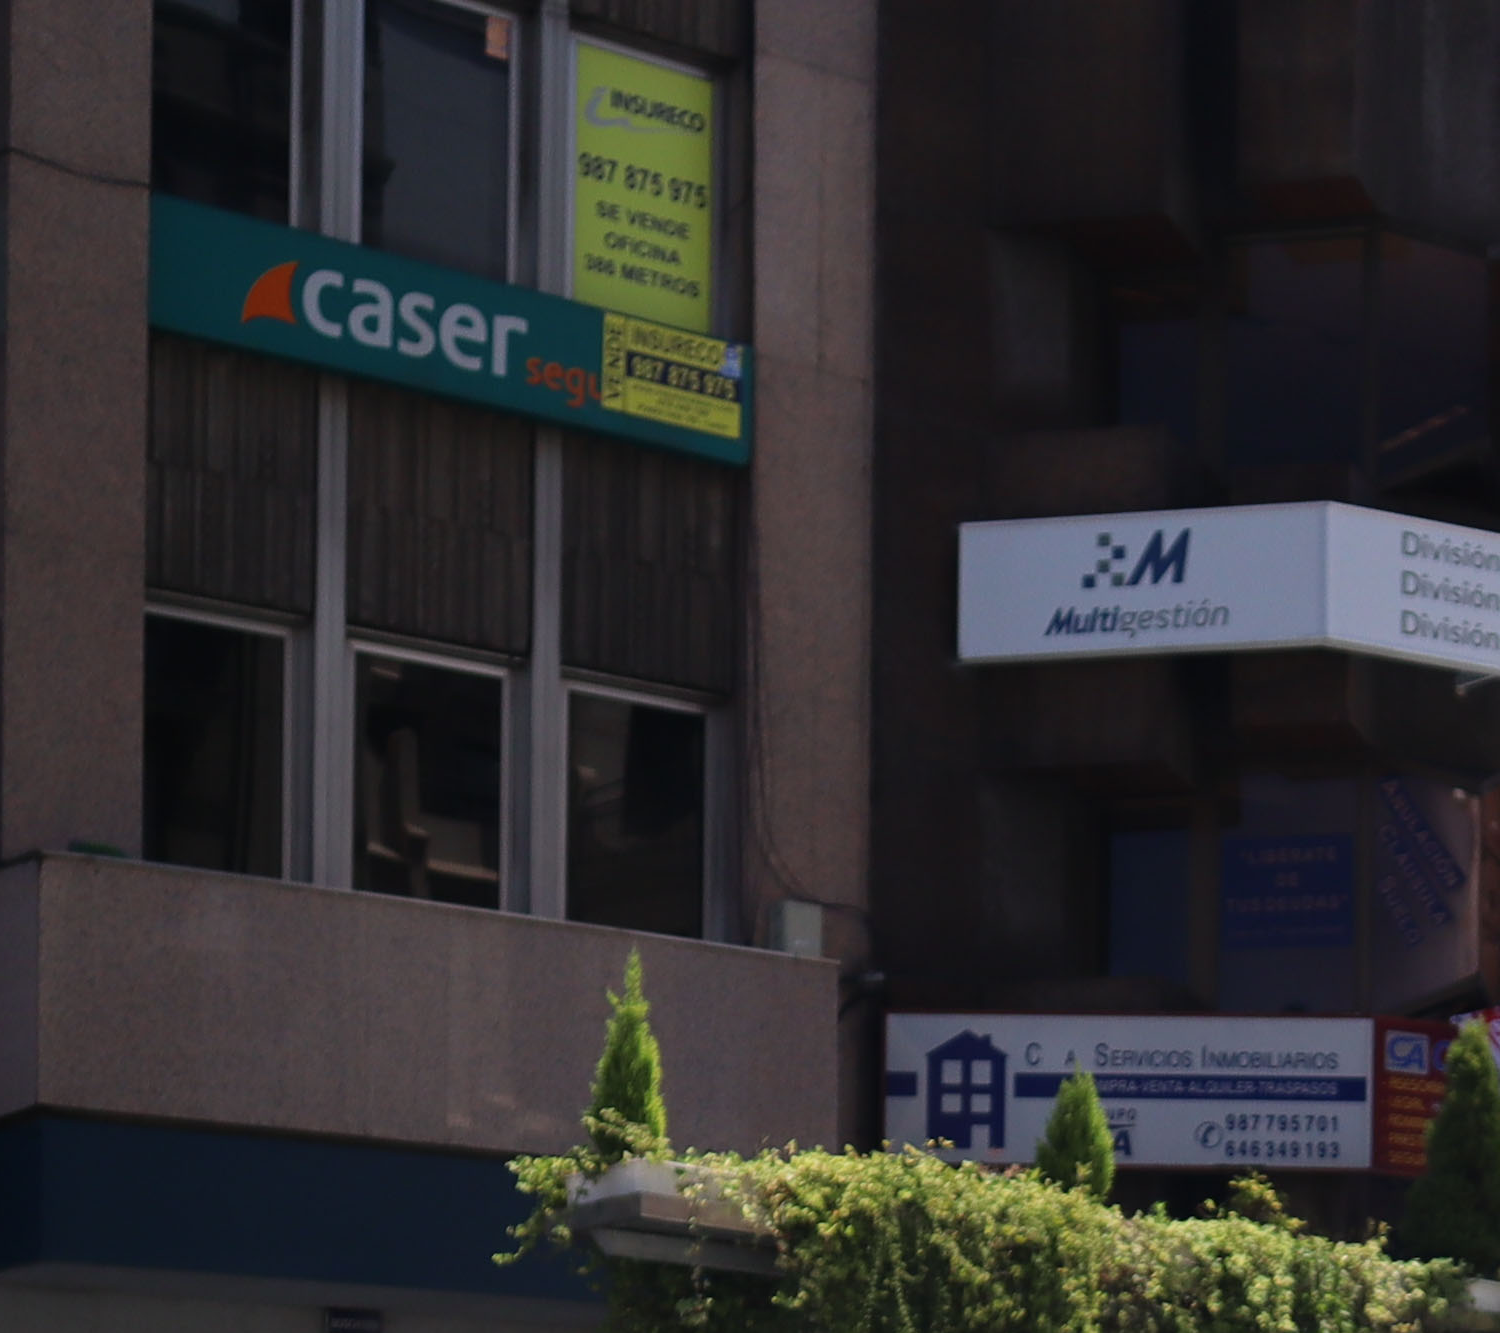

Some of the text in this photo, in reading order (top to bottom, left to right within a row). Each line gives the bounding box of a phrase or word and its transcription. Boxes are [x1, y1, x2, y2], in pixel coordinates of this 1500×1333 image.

[578, 152, 707, 209] 987 875 975
[302, 268, 529, 378] caser
[525, 356, 603, 408] segu
[1401, 530, 1500, 573] División
[1401, 570, 1500, 612] División
[1044, 599, 1229, 638] Multigestión
[1401, 609, 1500, 649] División
